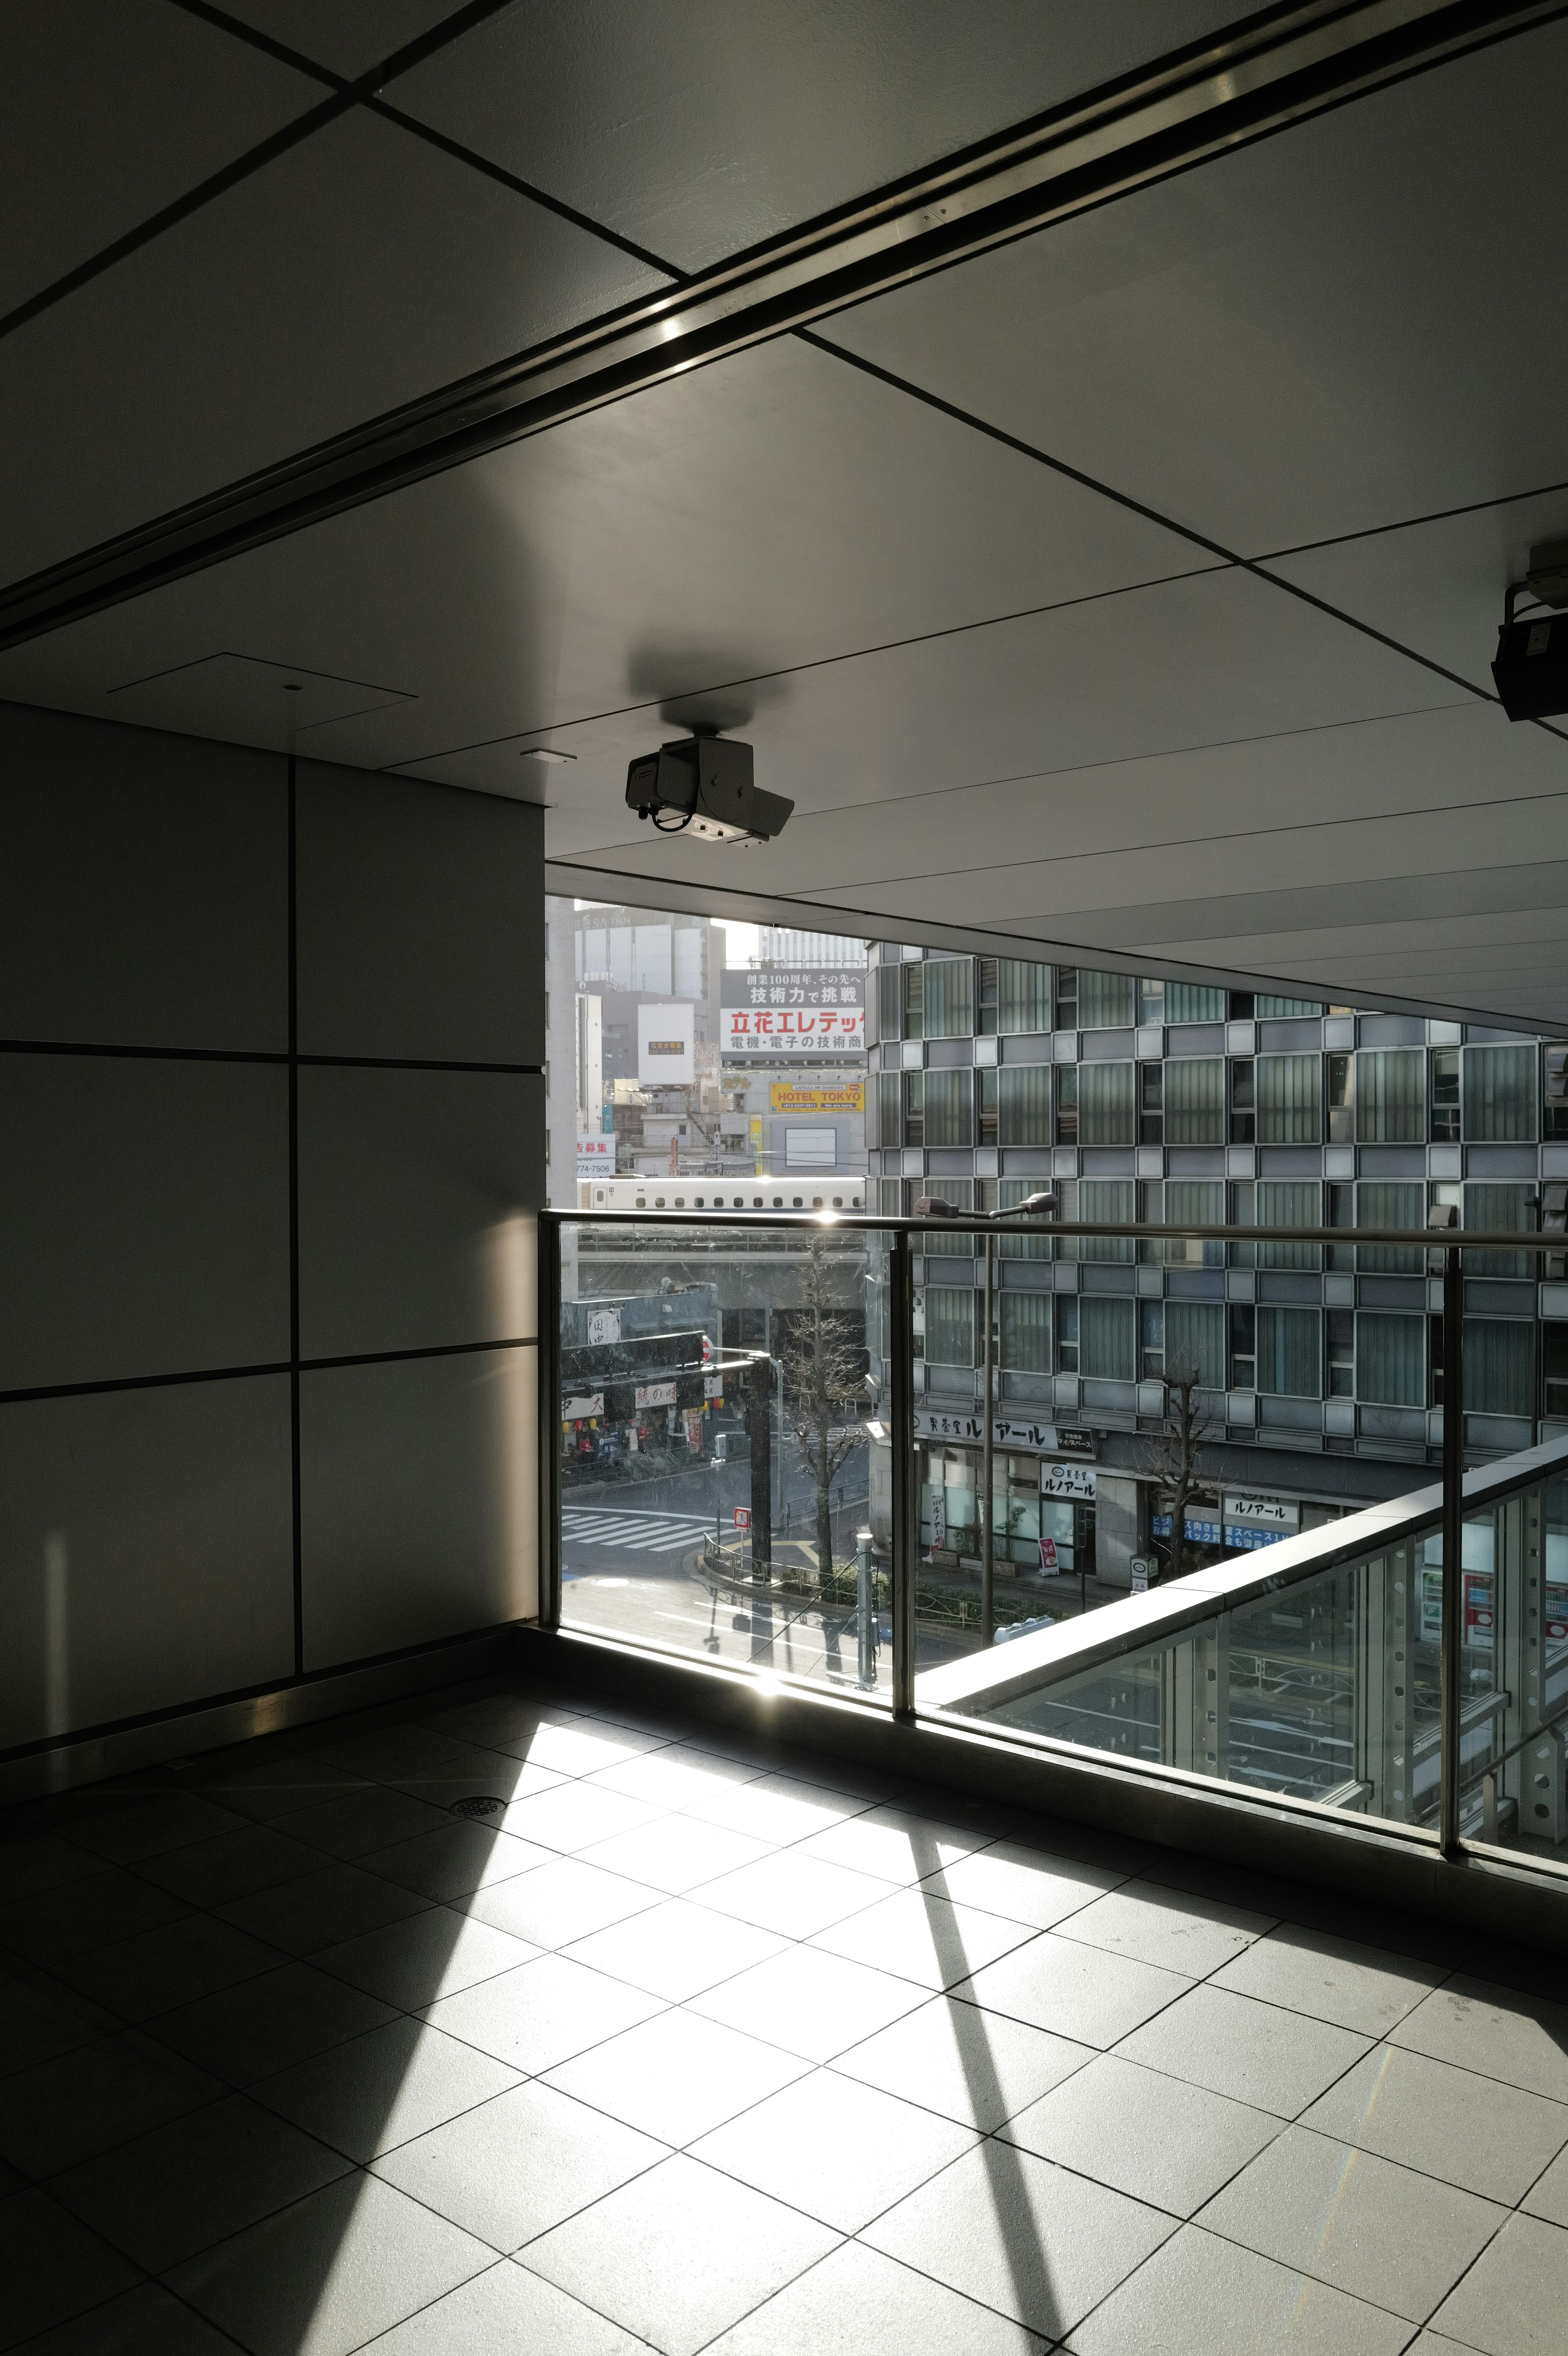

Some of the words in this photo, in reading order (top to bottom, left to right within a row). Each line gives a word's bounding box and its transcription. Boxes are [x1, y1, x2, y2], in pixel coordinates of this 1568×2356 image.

[746, 974, 861, 985] 創業100周年、その先へ
[751, 986, 857, 1004] 技術力で挑戦
[731, 1011, 864, 1033] 立花エレテッ
[731, 1035, 861, 1049] 電機・電子の技術商
[778, 1093, 815, 1101] HOTEL
[821, 1092, 861, 1101] TOKYO
[1045, 1478, 1096, 1497] ルノアール
[1235, 1501, 1286, 1519] ルノアール
